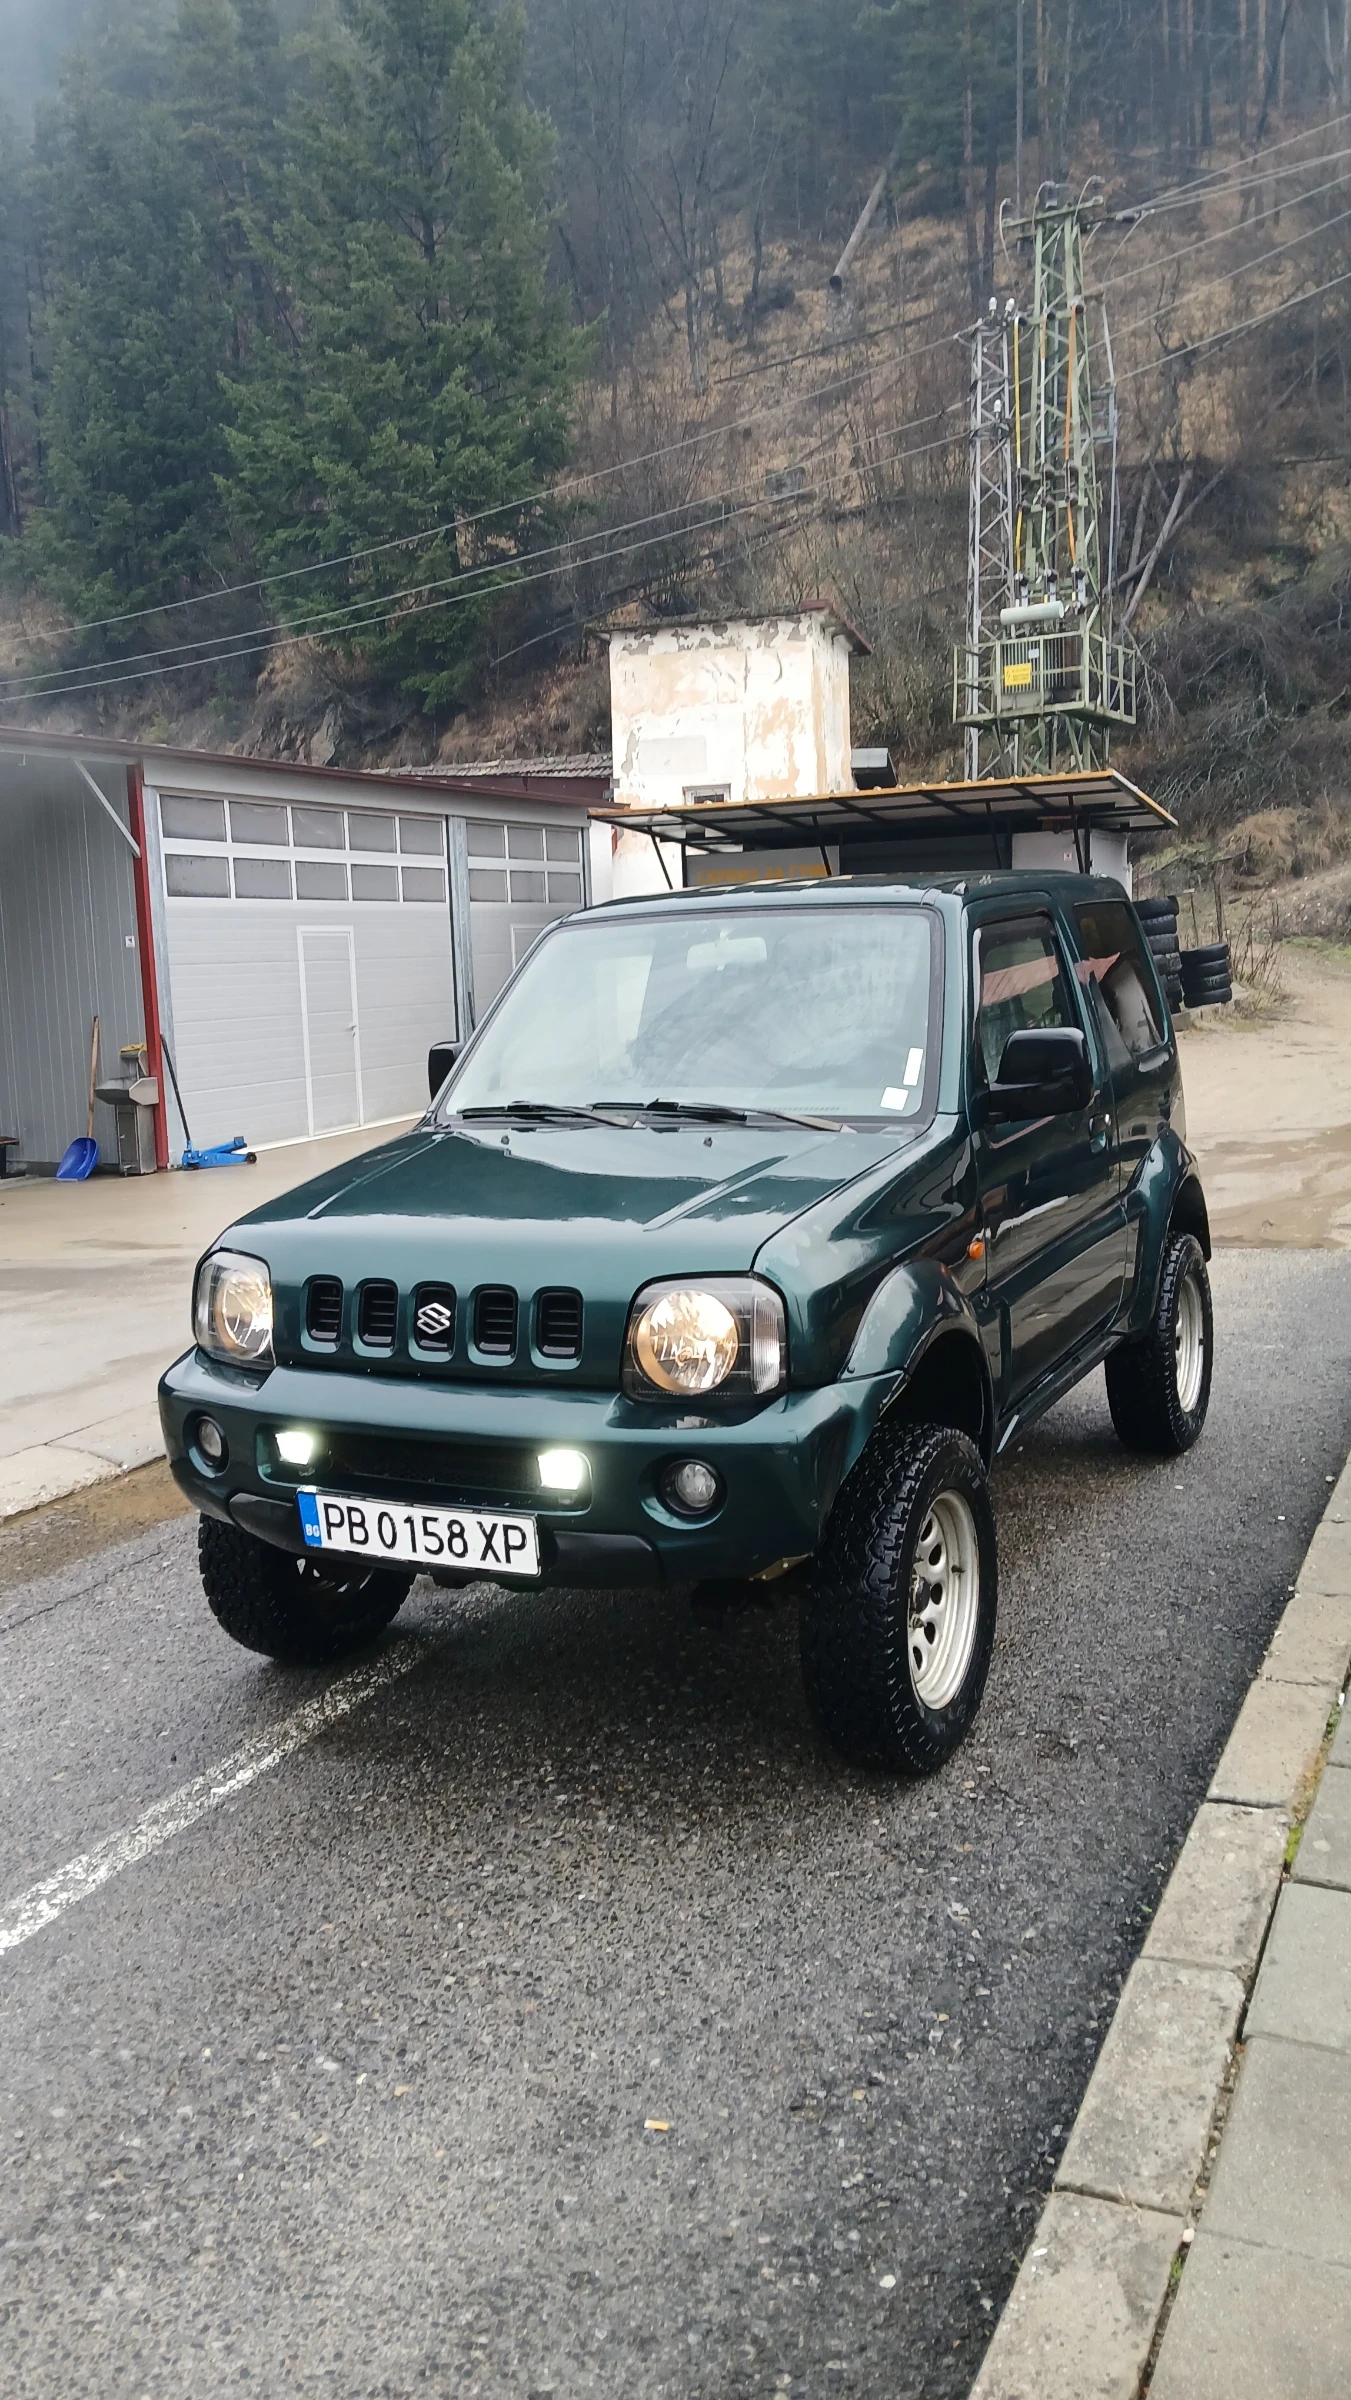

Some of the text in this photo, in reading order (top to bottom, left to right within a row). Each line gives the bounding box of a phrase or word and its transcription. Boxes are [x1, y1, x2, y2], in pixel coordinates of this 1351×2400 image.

[305, 1523, 320, 1538] BG
[323, 1502, 528, 1564] PB 0158 XP
